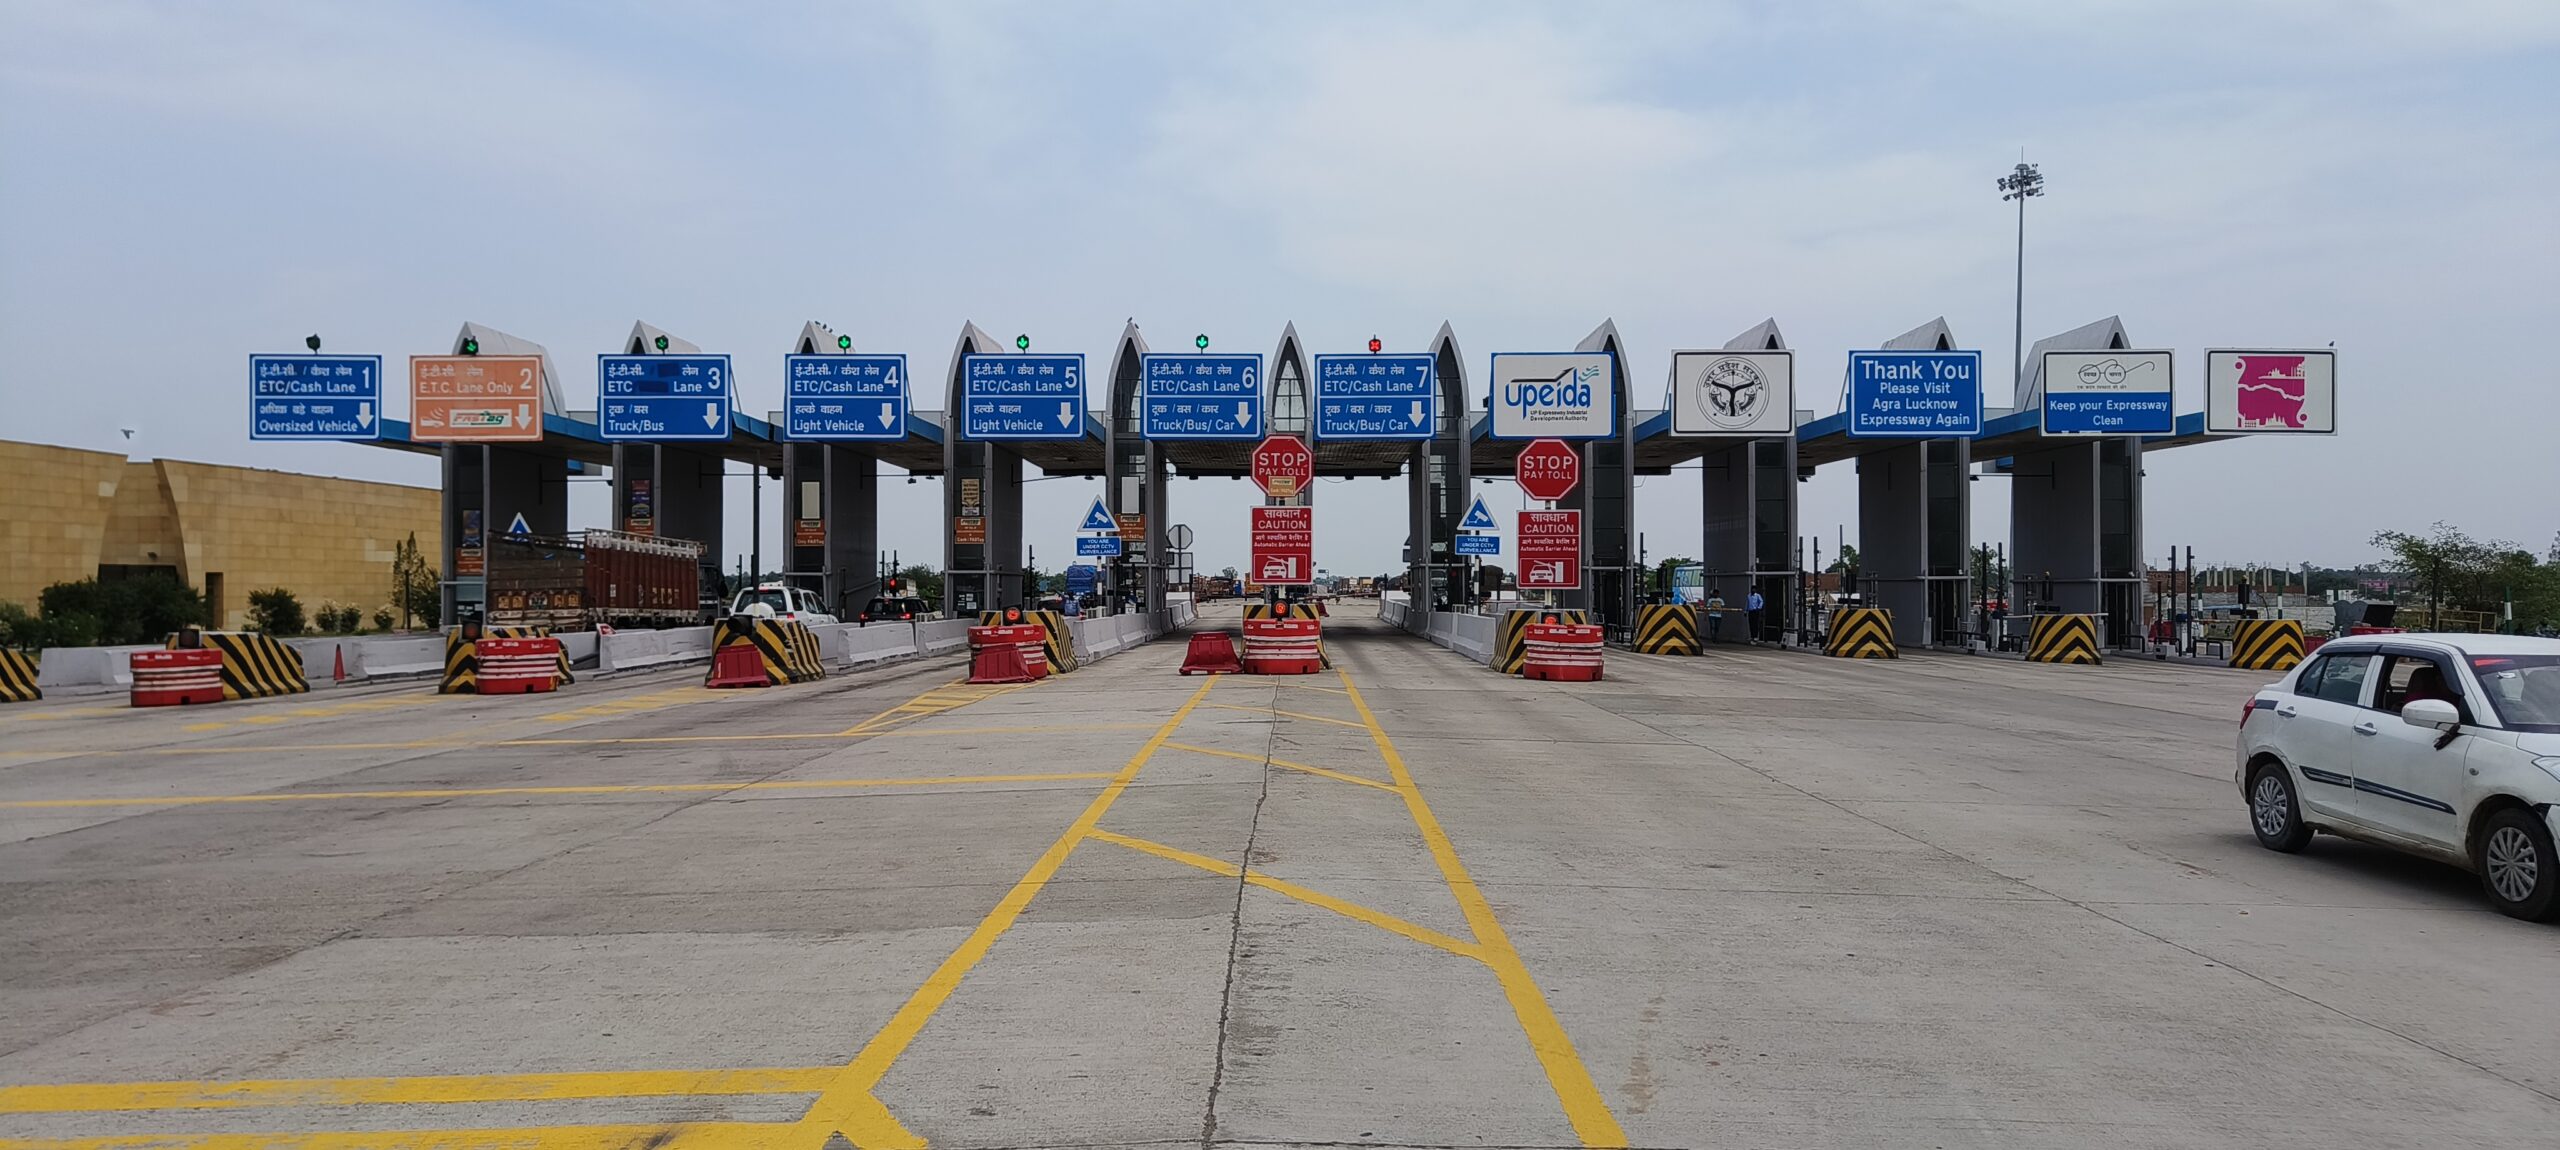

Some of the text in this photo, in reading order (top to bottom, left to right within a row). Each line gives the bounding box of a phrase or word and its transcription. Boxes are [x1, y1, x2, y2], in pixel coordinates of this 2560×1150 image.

[682, 365, 698, 376] लेन
[865, 364, 879, 375] लेन
[1039, 364, 1054, 375] लेन
[1217, 364, 1232, 375] लेन
[1391, 364, 1405, 375] लेन
[1861, 361, 1969, 379] Thank You
[362, 366, 369, 388] 1
[520, 368, 532, 389] 2
[708, 368, 720, 389] 3
[884, 366, 898, 388] 4
[1065, 367, 1077, 388] 5
[1243, 367, 1255, 388] 6
[1416, 366, 1428, 388] 7
[260, 381, 356, 394] ETC/Cash Lane
[457, 383, 483, 393] Lane
[487, 382, 513, 394] Only
[608, 381, 702, 392] ETC Lane
[795, 381, 883, 394] ETC/Cash Lane
[973, 380, 1062, 393] ETC/Cash Lane
[1151, 381, 1240, 394] ETC/Cash Lane
[1324, 381, 1413, 394] ETC/Cash Lane
[1880, 382, 1950, 393] Please Visit
[1506, 368, 1591, 420] upeida
[795, 402, 842, 414] हल्के वाहन
[974, 402, 1021, 414] हल्के वाहन
[1873, 398, 1958, 411] Agra Lucknow
[2050, 400, 2167, 412] Keep your Expressway
[260, 420, 357, 432] Oversized Vehicle
[795, 420, 864, 432] Light Vehicle
[973, 420, 1043, 432] Light Vehicle
[1216, 419, 1235, 430] Car
[1389, 420, 1408, 430] Car
[1861, 414, 1970, 427] Expressway Again
[2093, 415, 2123, 425] Clean
[608, 420, 664, 433] Truck/Bus
[1259, 453, 1306, 466] STOP
[1524, 456, 1572, 469] STOP
[1259, 468, 1306, 476] PAY TOLL
[1524, 471, 1571, 479] PAY TOLL
[1264, 510, 1300, 518] सावधान
[1530, 514, 1568, 522] सावधान
[1258, 520, 1306, 529] CAUTION
[1525, 524, 1574, 533] CAUTION
